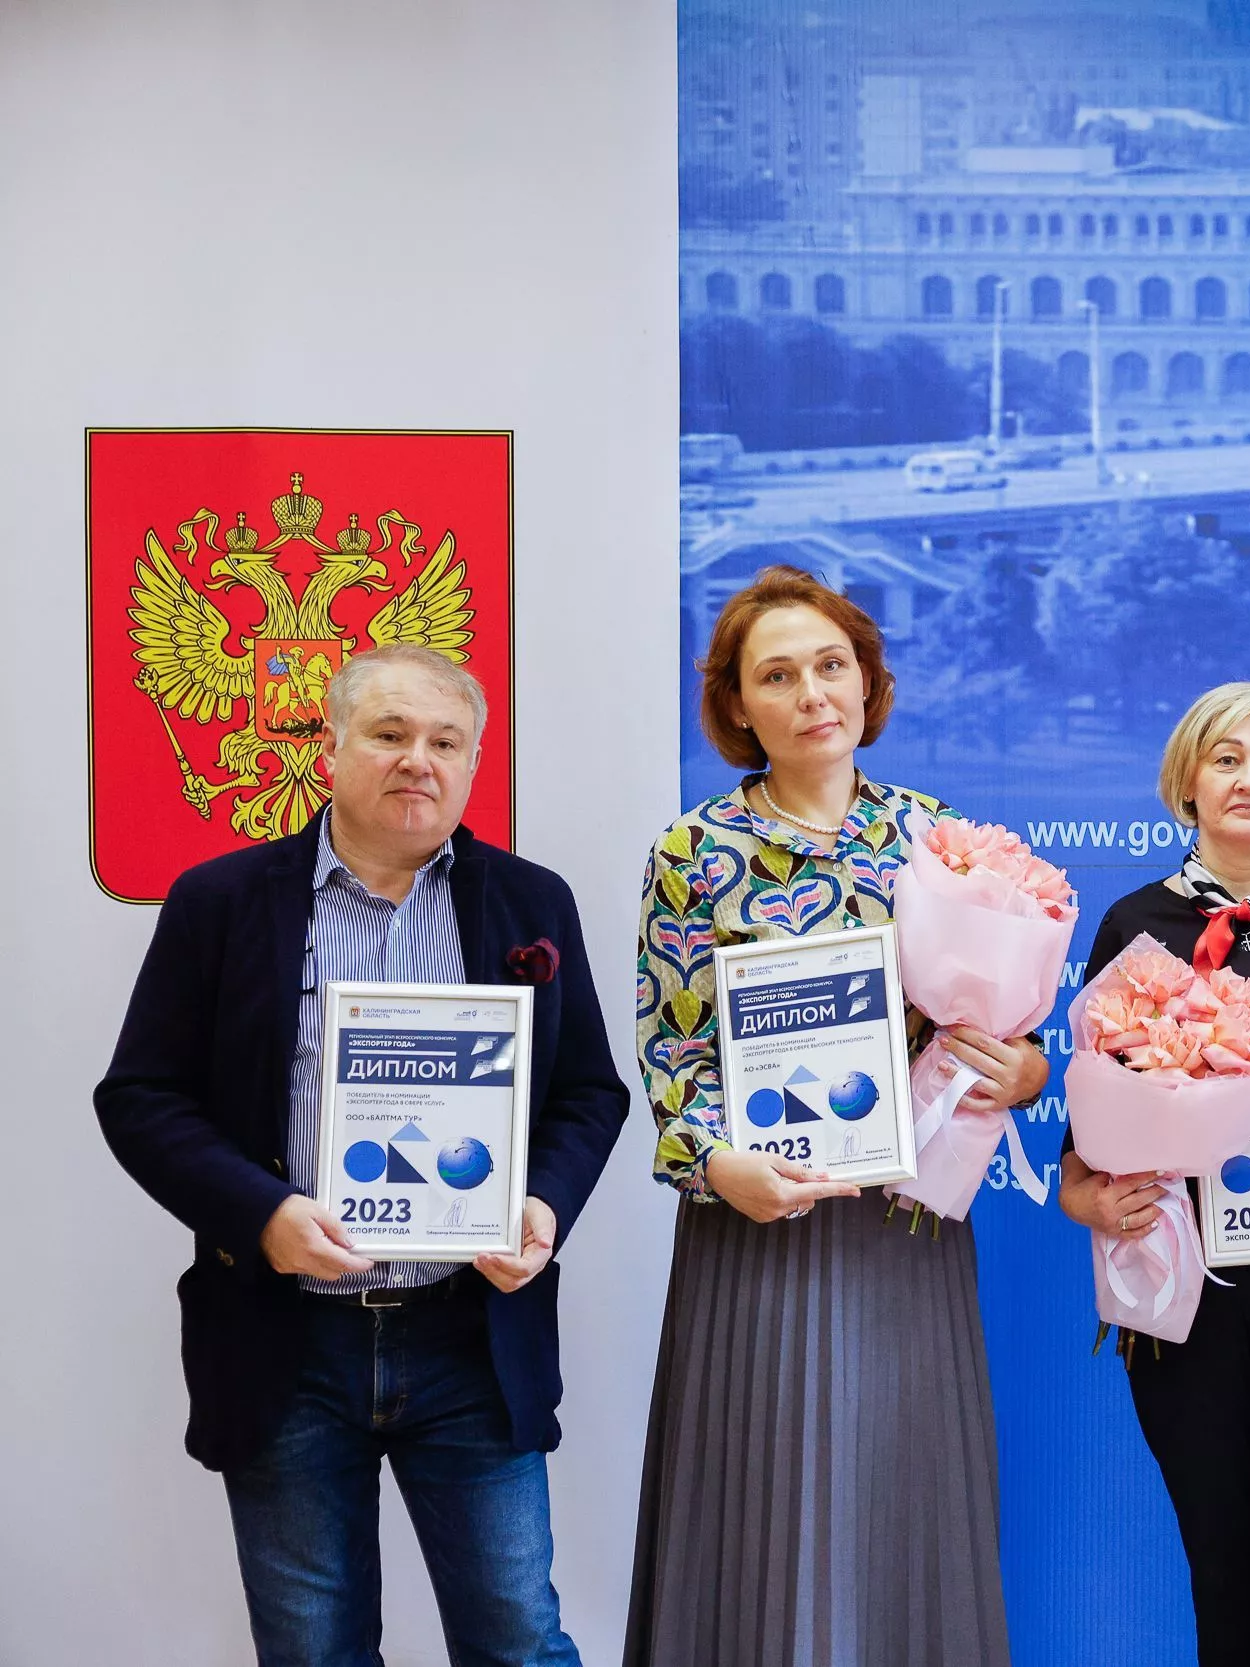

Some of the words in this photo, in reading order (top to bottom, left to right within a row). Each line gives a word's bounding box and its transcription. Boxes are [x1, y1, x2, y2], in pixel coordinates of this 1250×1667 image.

[1027, 820, 1199, 857] www.gov
[747, 961, 799, 972] КАЛИНИНГРАДСКАЯ
[738, 993, 777, 1005] «ЭКСПОРТЕР
[777, 991, 798, 1000] ГОДА»
[740, 1003, 836, 1035] ДИПЛОМ
[348, 1039, 392, 1048] «ЭКСПОРТЕР
[347, 1059, 457, 1080] ДИПЛОМ
[755, 1062, 781, 1072] «ЭСВА»
[366, 1114, 403, 1122] «БАЛТМА
[340, 1198, 412, 1223] 2023
[388, 1227, 411, 1236] ГОДА
